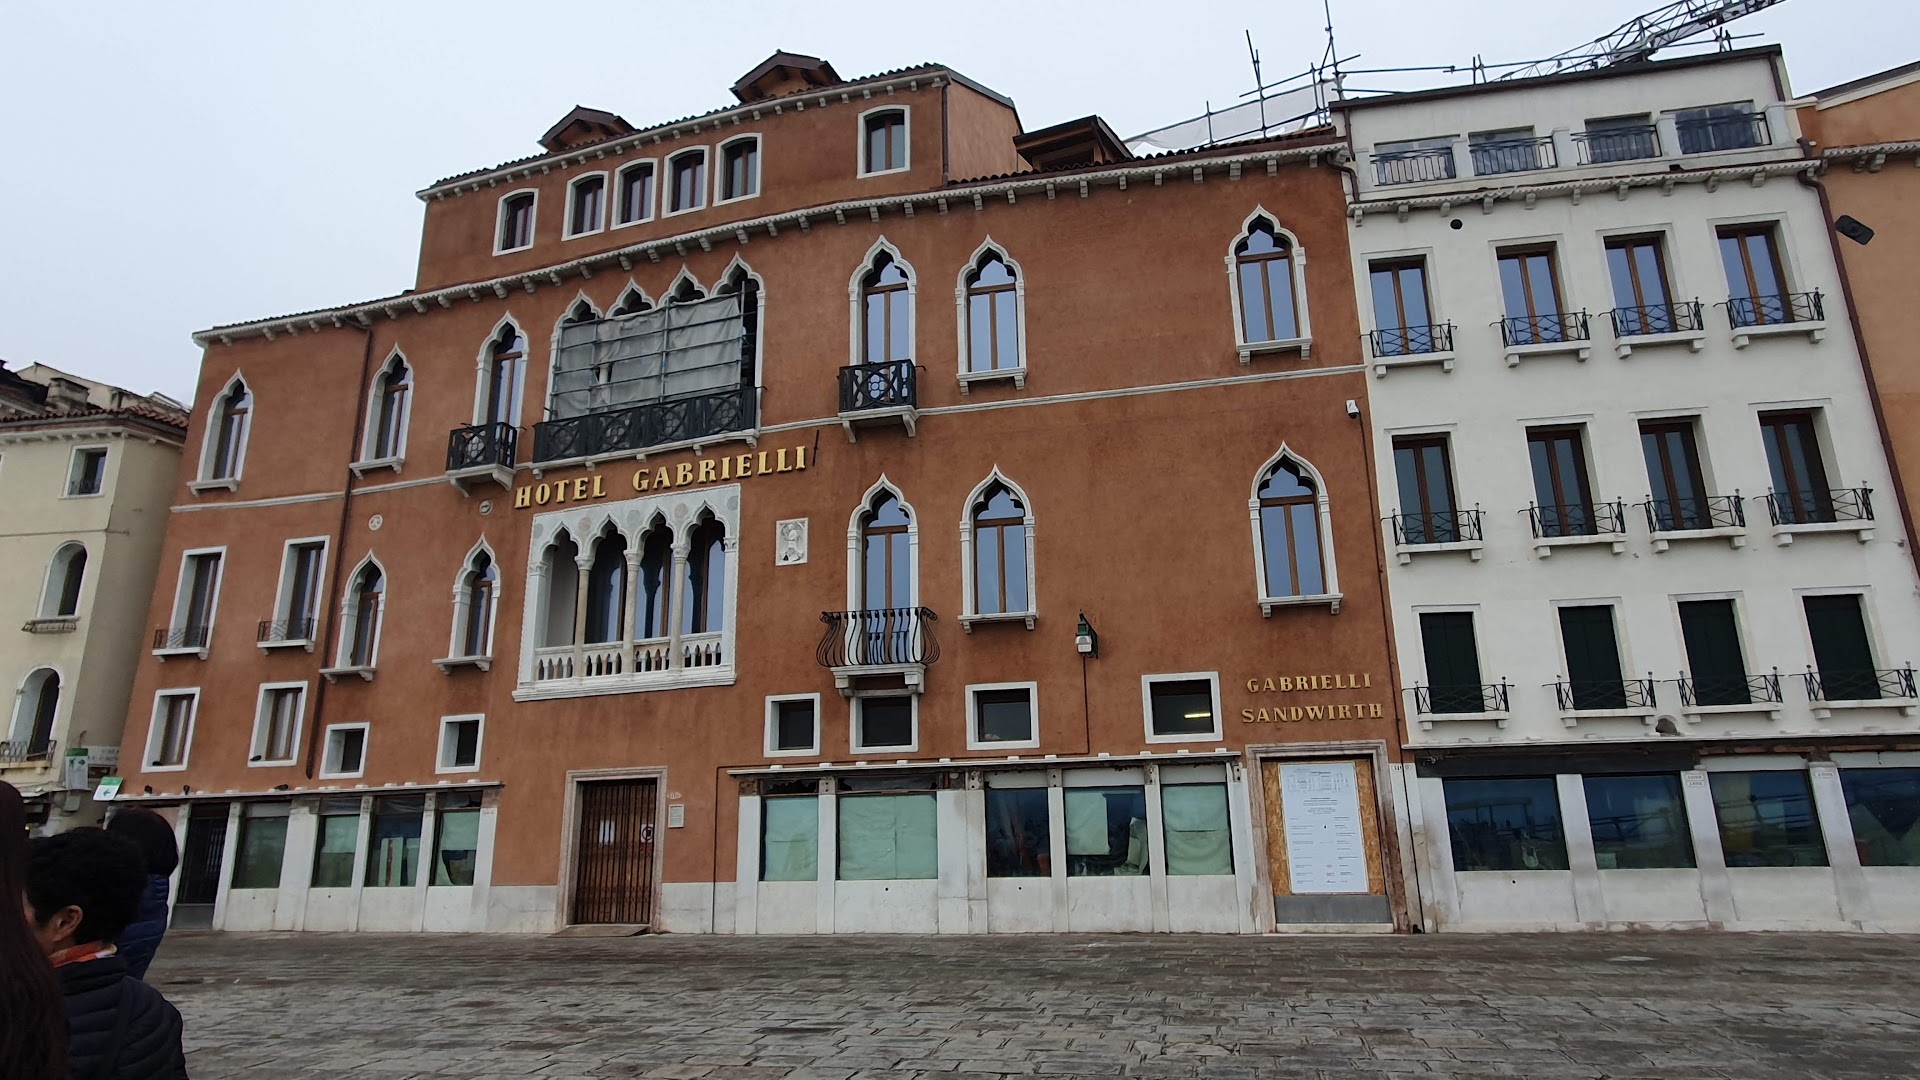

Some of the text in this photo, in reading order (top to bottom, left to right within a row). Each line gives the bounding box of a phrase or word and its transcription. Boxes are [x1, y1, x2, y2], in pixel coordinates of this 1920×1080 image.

[514, 446, 806, 509] HOTEL GABRIELLI
[1246, 673, 1372, 693] GABRIELLI
[1241, 703, 1384, 723] SANDWIRTH
